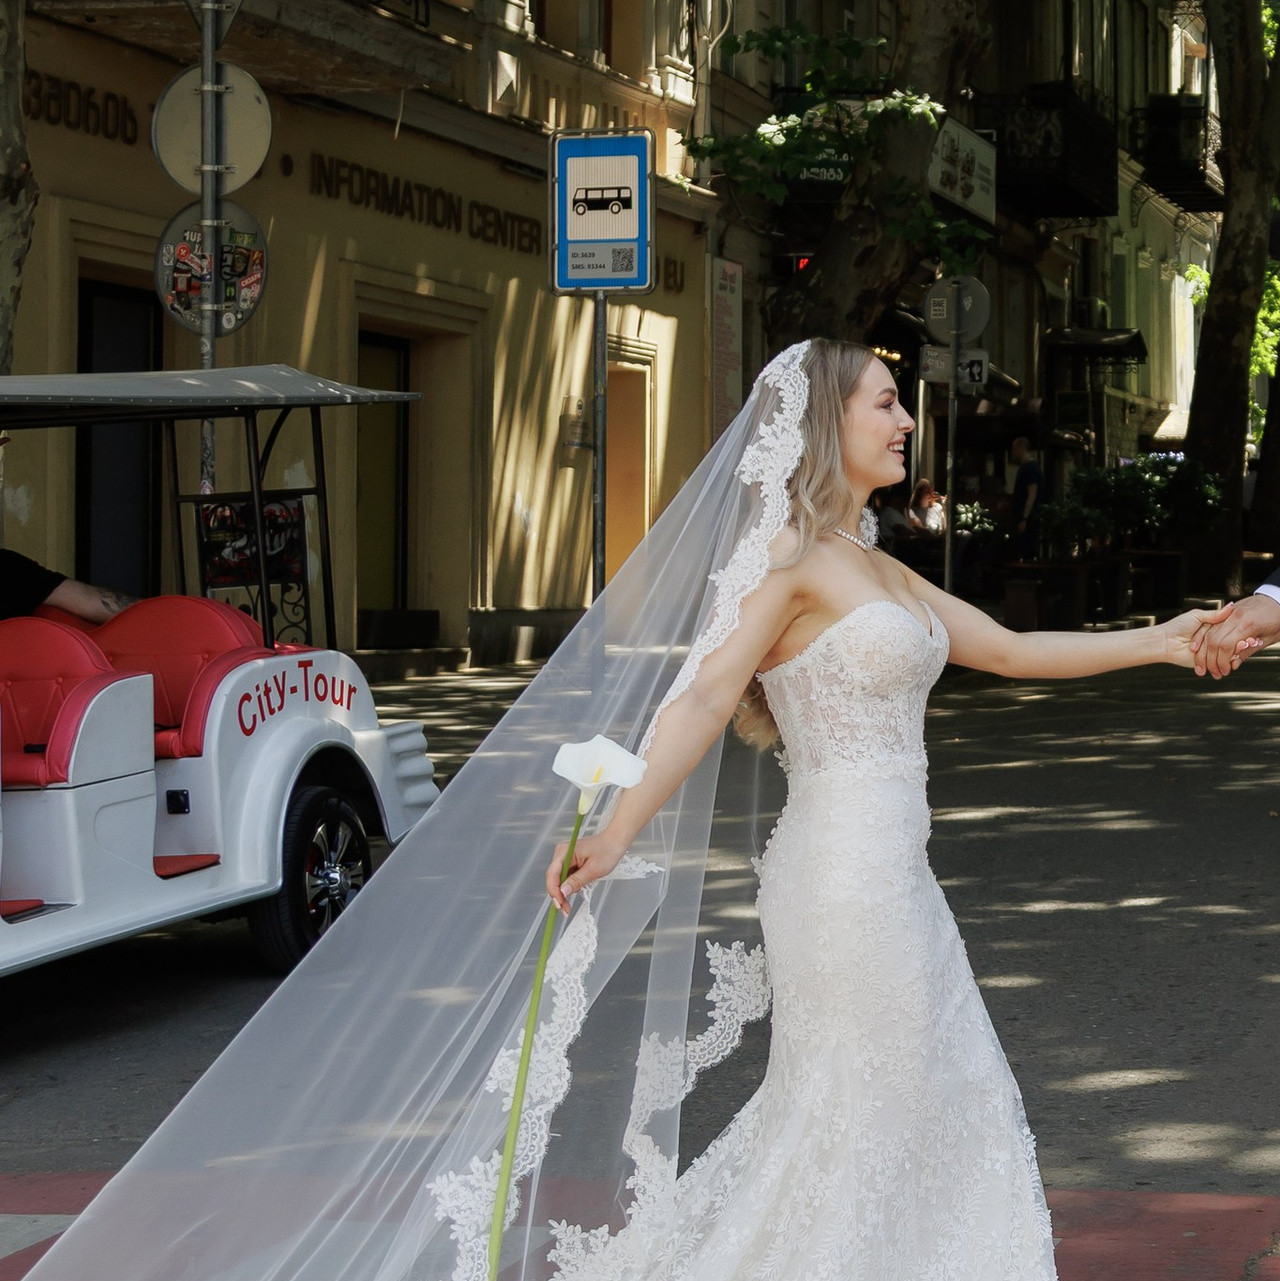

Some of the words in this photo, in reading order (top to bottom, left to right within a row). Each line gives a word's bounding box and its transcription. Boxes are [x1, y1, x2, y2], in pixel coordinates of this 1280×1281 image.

[309, 150, 463, 234] INFORMATION
[467, 200, 542, 256] CENTER
[664, 257, 684, 293] EU
[237, 659, 357, 737] City-Tour
